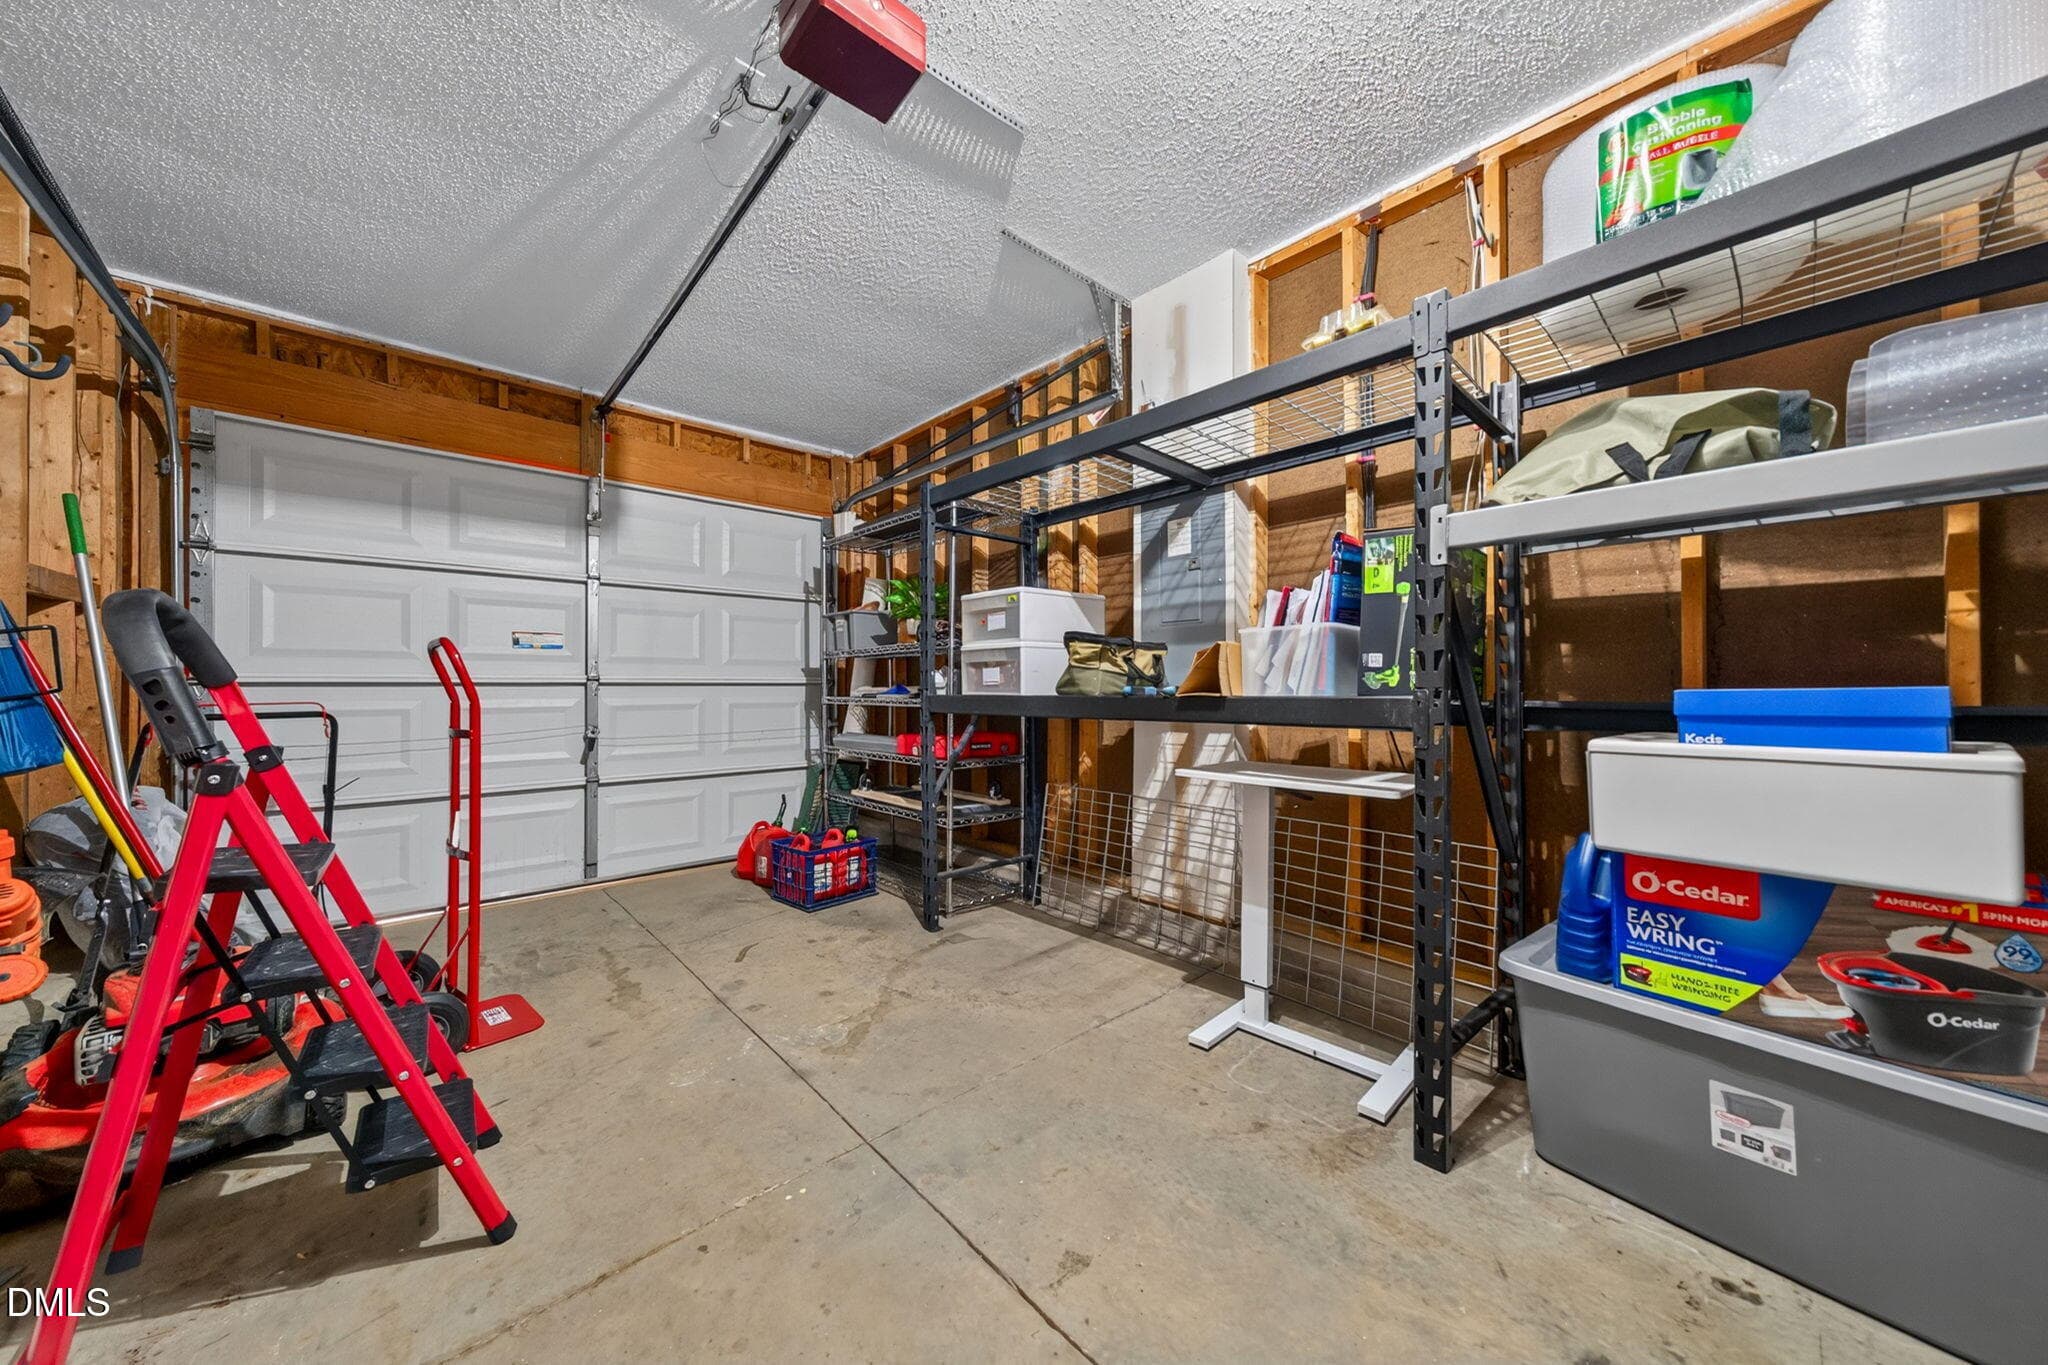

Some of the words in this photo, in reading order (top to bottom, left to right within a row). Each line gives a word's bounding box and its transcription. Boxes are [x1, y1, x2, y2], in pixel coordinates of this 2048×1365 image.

[1647, 108, 1706, 136] Bbble
[1633, 146, 1671, 167] SALL
[1684, 732, 1724, 745] Keds
[1632, 870, 1750, 907] O-Cedar
[1626, 906, 1686, 932] EASY
[1884, 896, 1949, 915] AMERICA'S
[1981, 911, 2014, 924] SPIN
[1671, 982, 1732, 1004] WRINGING
[1926, 1011, 2001, 1031] O-Cedar
